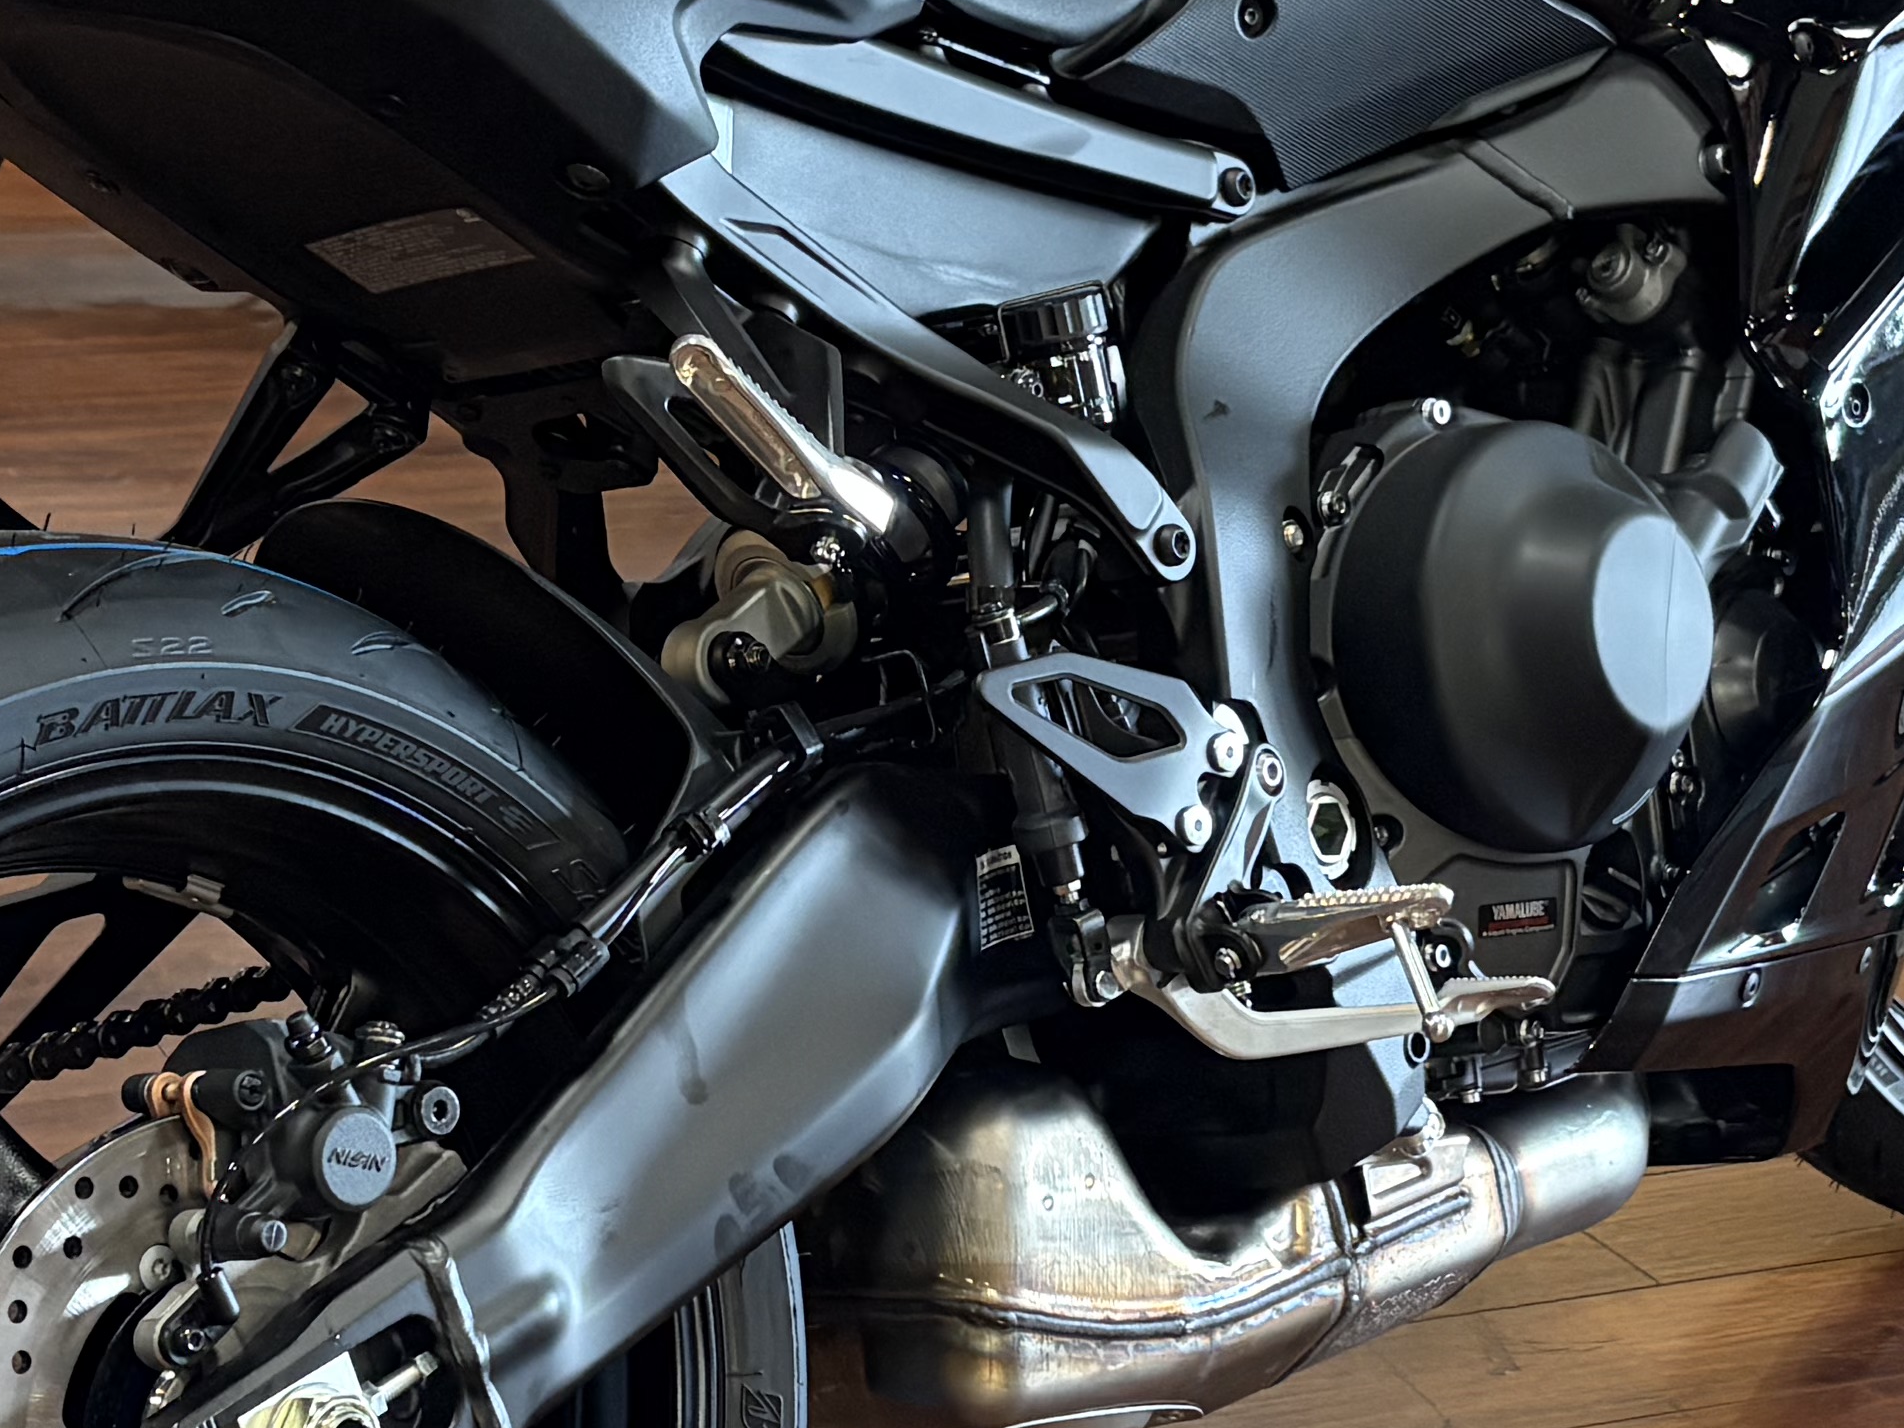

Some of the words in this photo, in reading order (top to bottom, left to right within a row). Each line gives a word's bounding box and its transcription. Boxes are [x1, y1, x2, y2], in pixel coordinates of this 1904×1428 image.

[130, 635, 213, 658] S22
[34, 690, 284, 749] BATTLAX
[319, 711, 498, 805] HYPERSPORT
[1492, 900, 1546, 921] YAMALUBE
